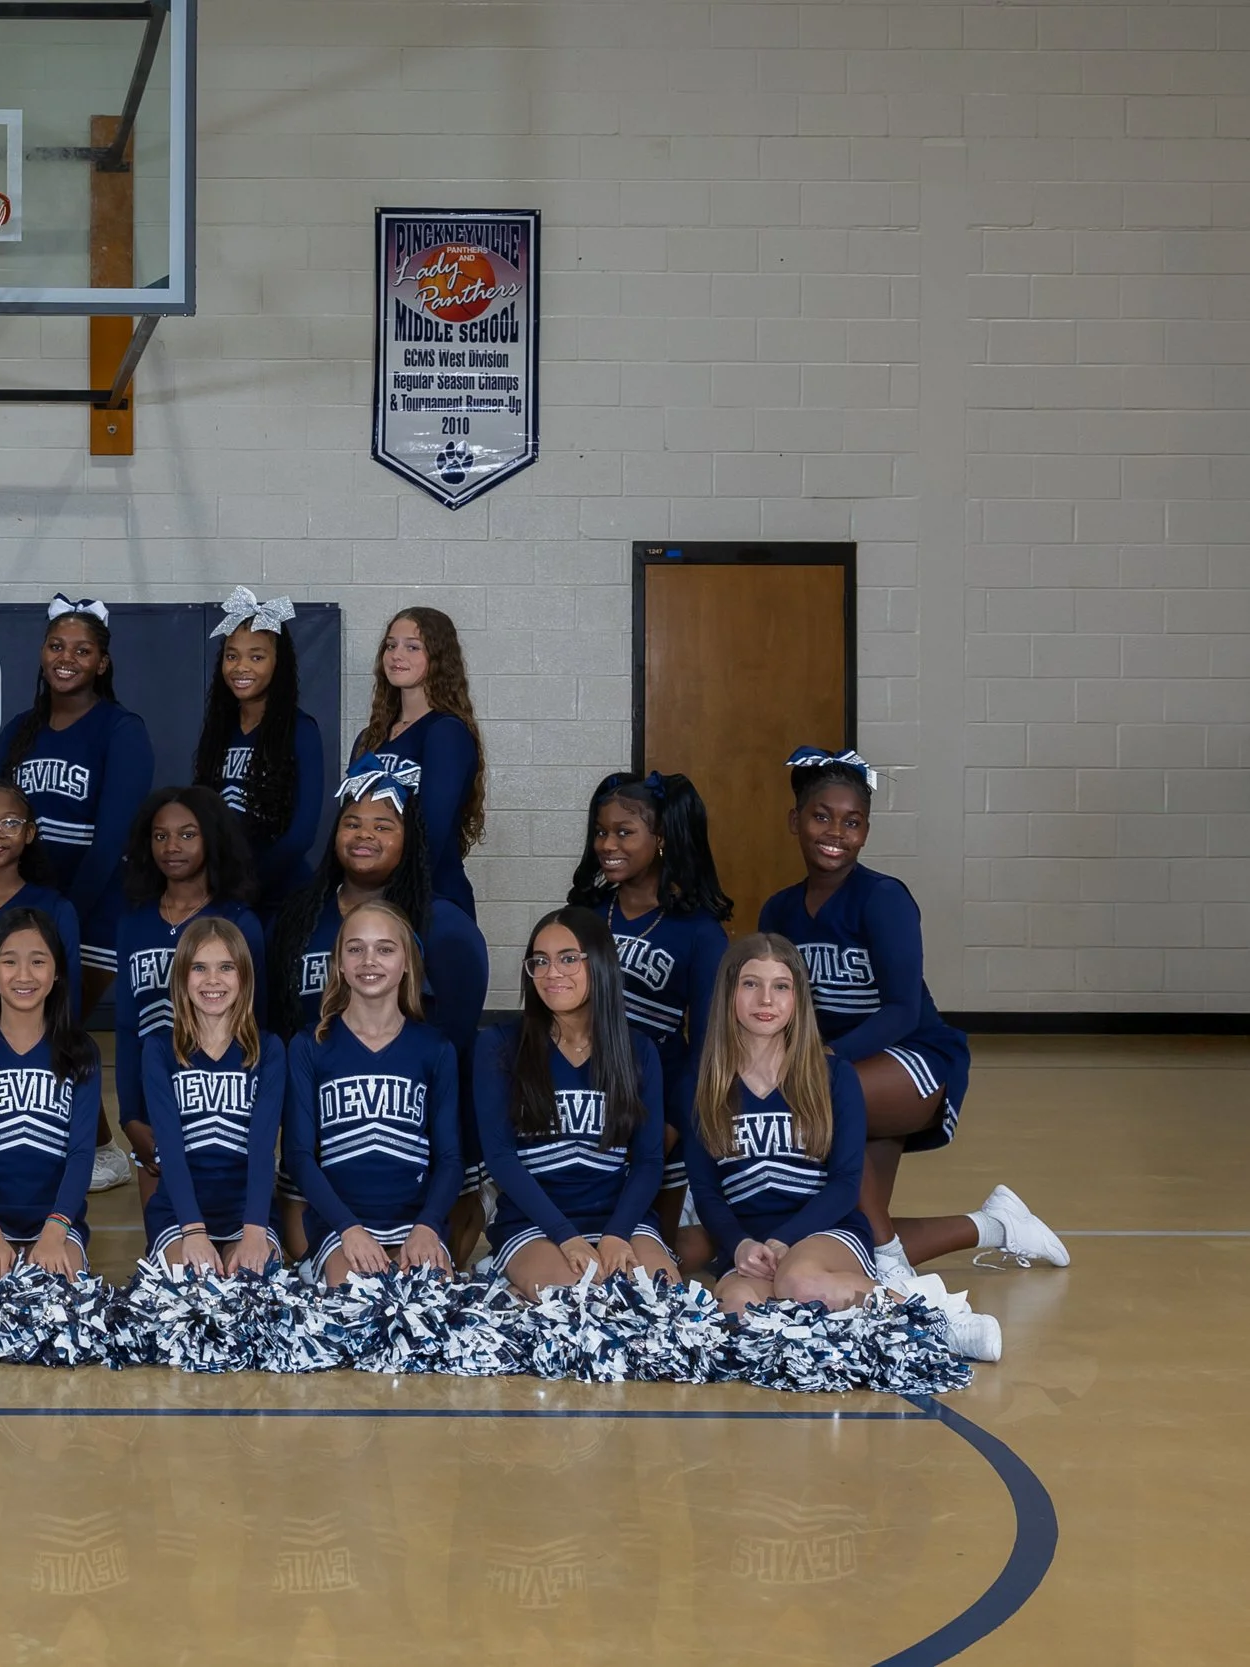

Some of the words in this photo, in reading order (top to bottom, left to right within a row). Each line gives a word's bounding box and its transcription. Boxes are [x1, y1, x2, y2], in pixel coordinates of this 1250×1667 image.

[395, 223, 520, 272] PINCKNEYVILLE
[446, 246, 489, 254] PANTHERS
[458, 254, 476, 262] AND
[392, 252, 463, 290] Lady
[415, 277, 522, 313] Panthers
[395, 297, 453, 342] MIDDLE
[459, 301, 519, 343] SCHOOL
[404, 349, 435, 367] GCMS
[439, 349, 466, 367] West
[469, 350, 509, 368] Division
[393, 371, 434, 391] Regular
[437, 372, 475, 390] Season
[478, 373, 519, 393] Champs
[390, 394, 398, 411] &
[401, 394, 463, 412] Tournament
[466, 395, 522, 416] Runner-Up
[442, 416, 470, 435] 2010
[172, 1069, 258, 1117] EVIL
[319, 1074, 428, 1129] DEVILS
